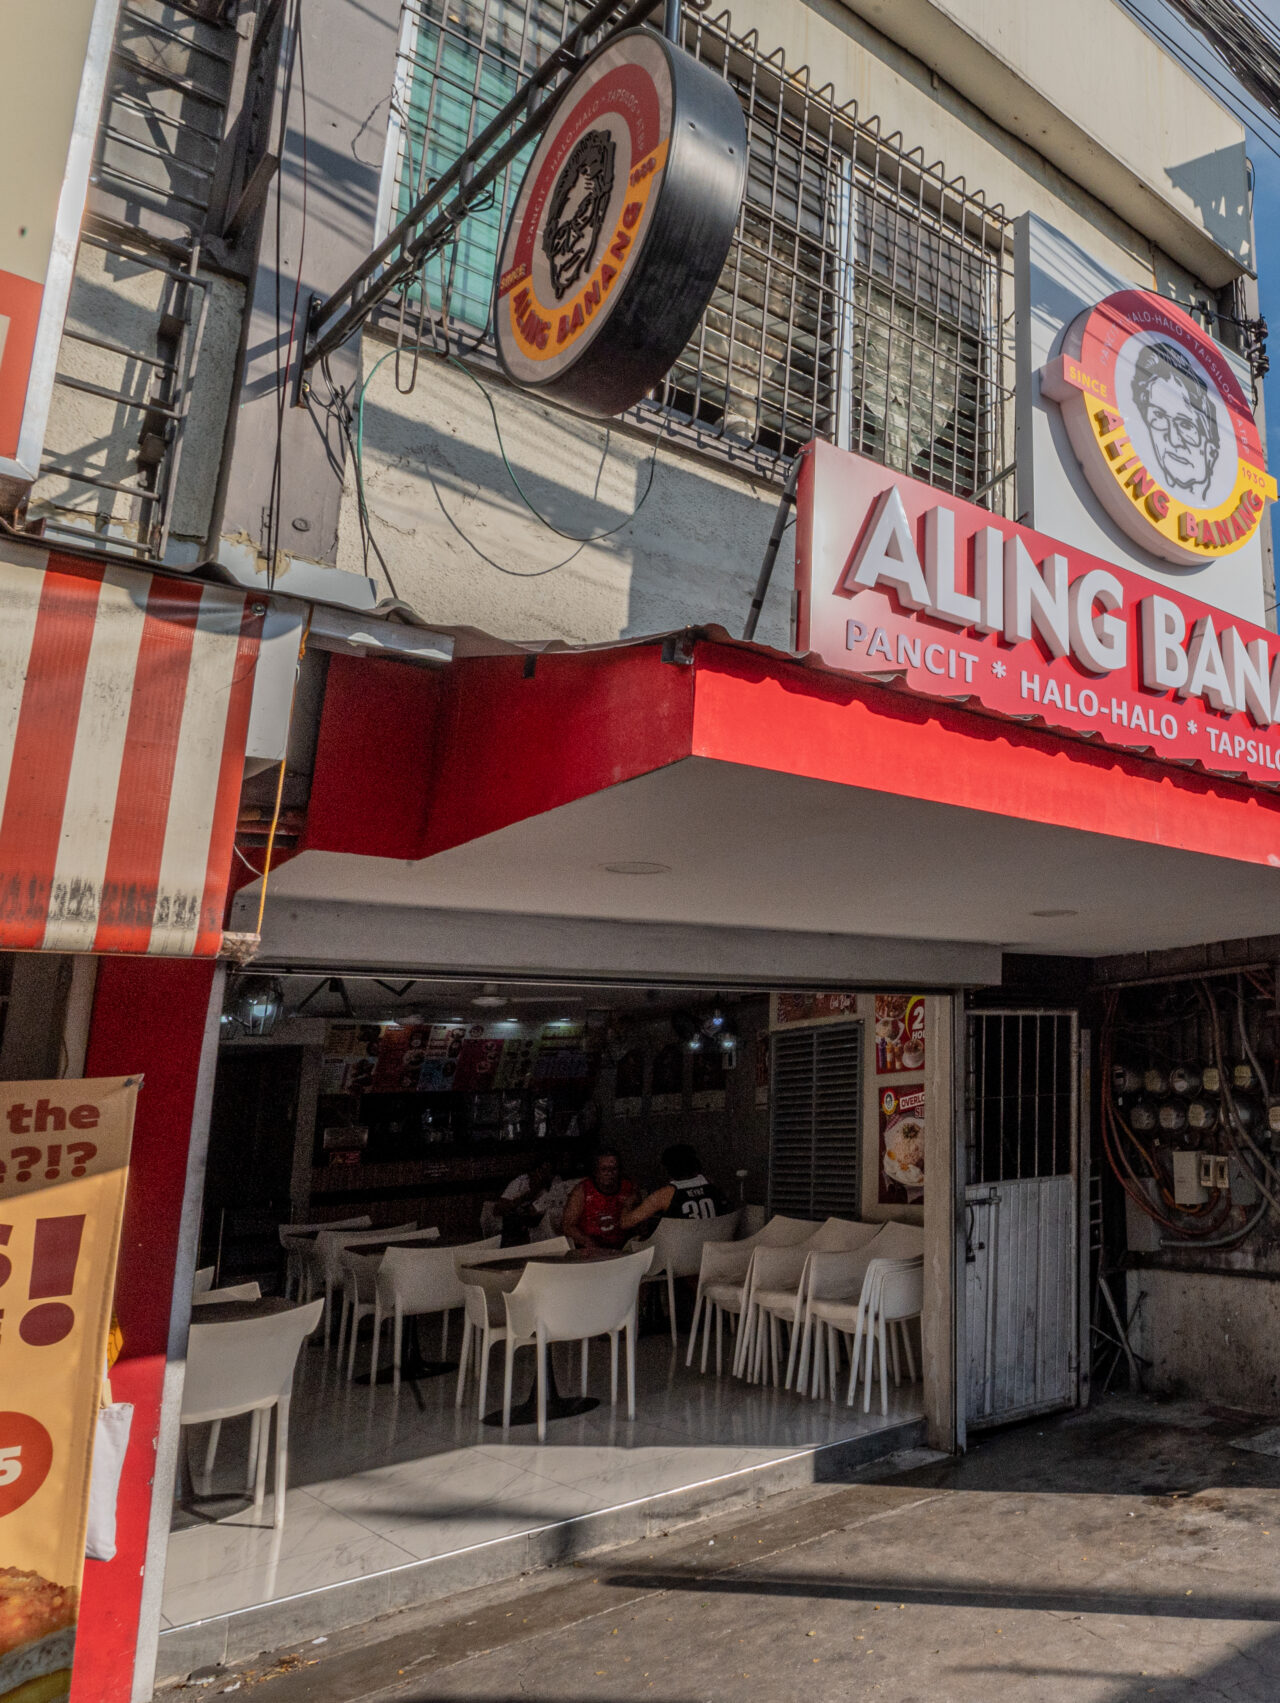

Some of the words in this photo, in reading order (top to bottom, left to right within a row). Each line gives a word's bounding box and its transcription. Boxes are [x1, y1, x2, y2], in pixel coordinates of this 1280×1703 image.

[512, 286, 552, 351] ALING
[556, 202, 643, 345] BANANG
[1126, 311, 1183, 337] HALO-HALO
[1193, 341, 1235, 405] TAPSILOG
[1068, 365, 1108, 398] SINCE
[1242, 466, 1266, 489] 1930
[1096, 408, 1170, 522] ALING
[1180, 488, 1264, 547] BANANG
[845, 484, 1127, 672] ALING
[846, 618, 979, 683] PANCIT
[1020, 670, 1178, 740] HALO-HALO
[6, 1099, 100, 1134] the
